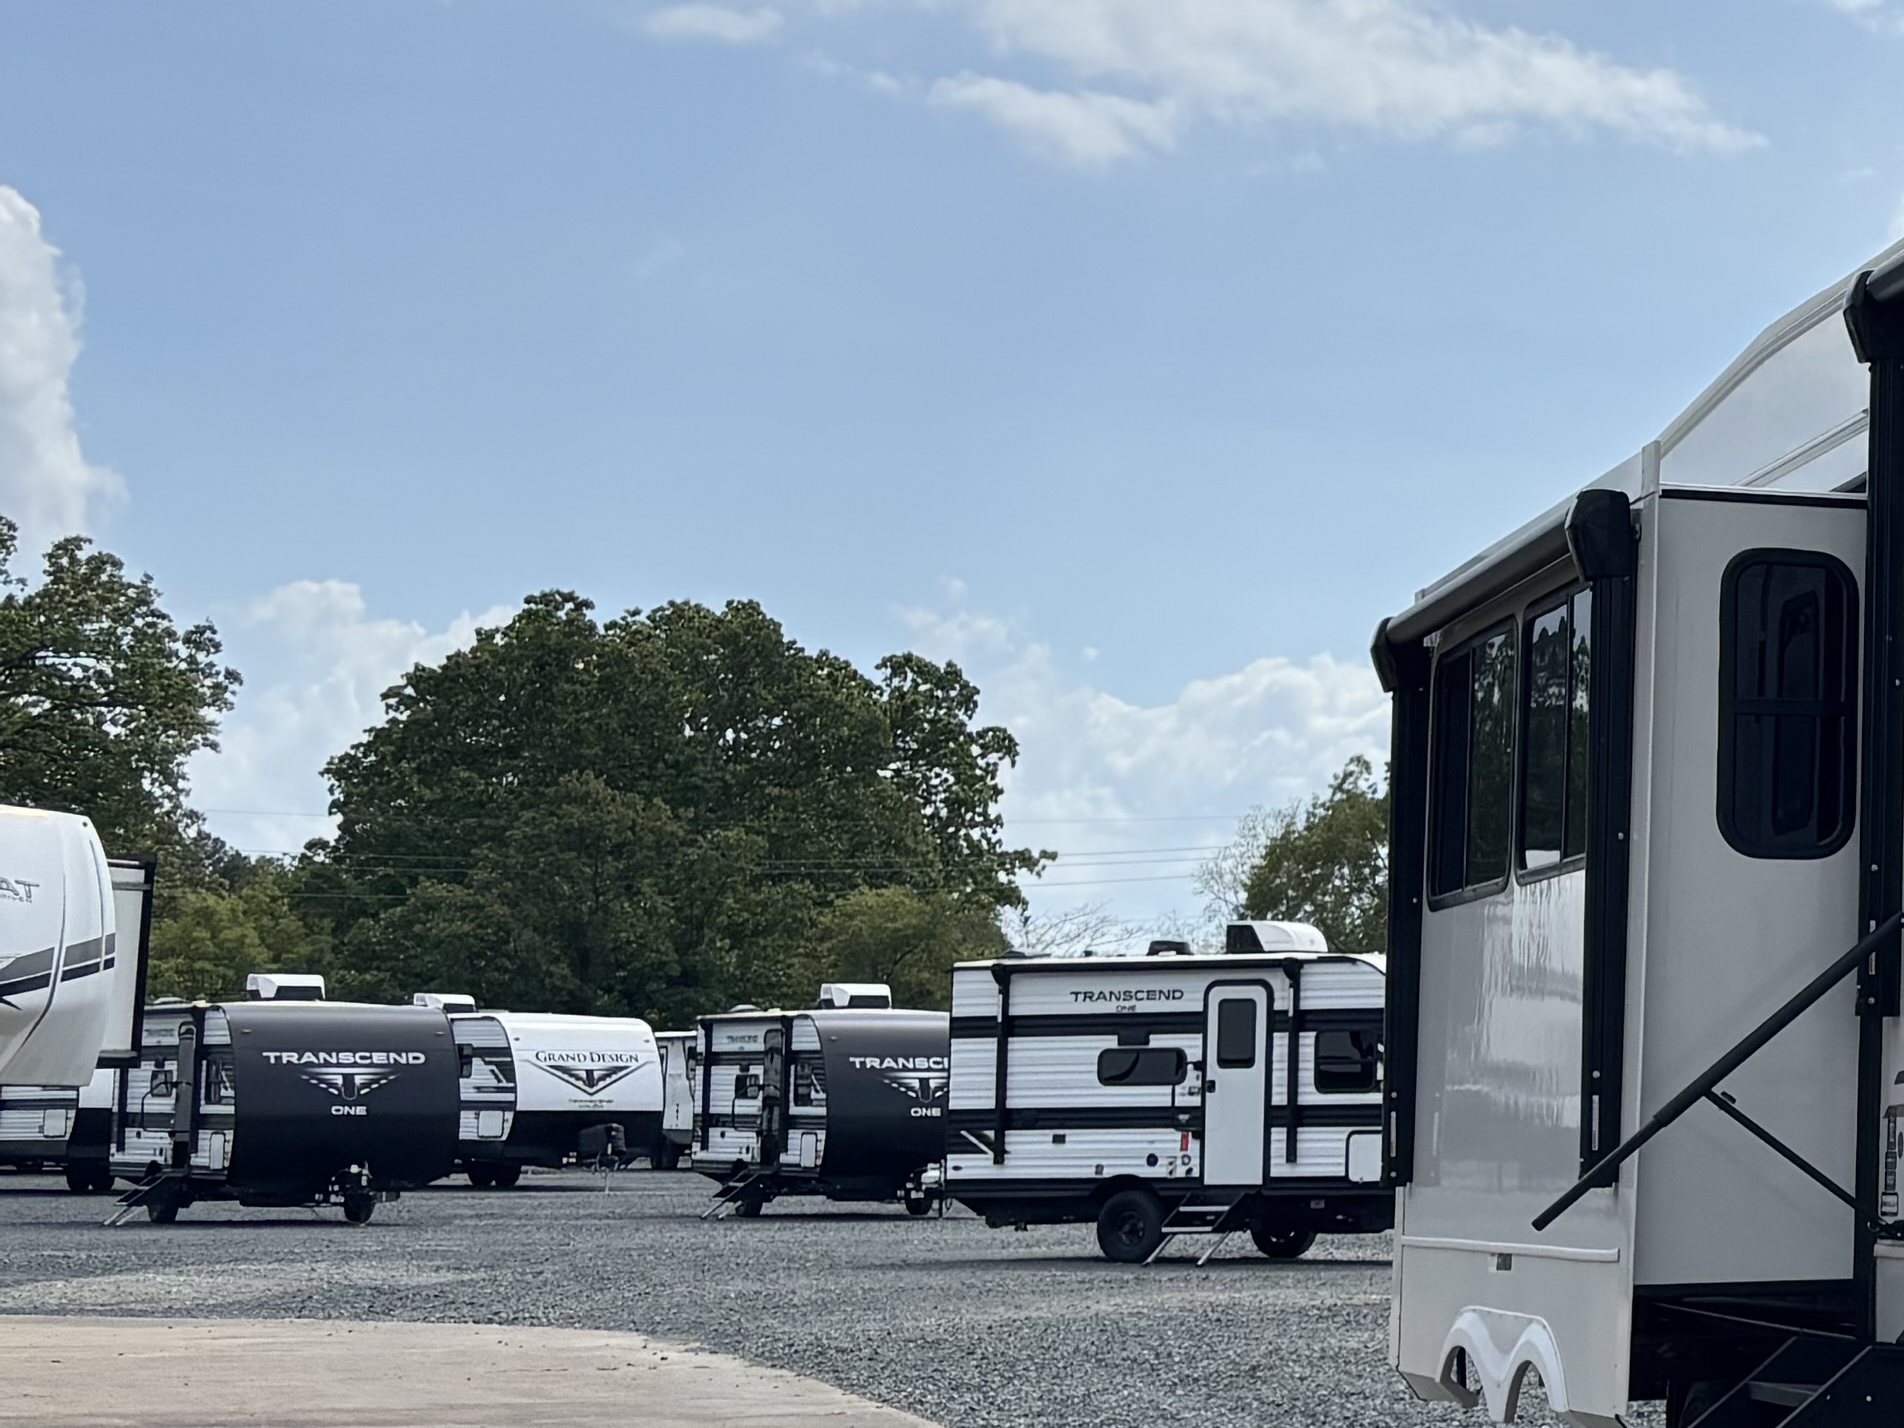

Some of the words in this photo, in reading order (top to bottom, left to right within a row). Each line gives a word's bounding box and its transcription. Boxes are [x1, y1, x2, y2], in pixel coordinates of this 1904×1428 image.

[1069, 989, 1184, 1003] TRANSCEND
[262, 1051, 426, 1064] TRANSCEND
[535, 1051, 587, 1063] GRAND
[589, 1051, 640, 1063] DESIGN
[331, 1106, 367, 1116] ONE
[910, 1107, 942, 1117] ONE
